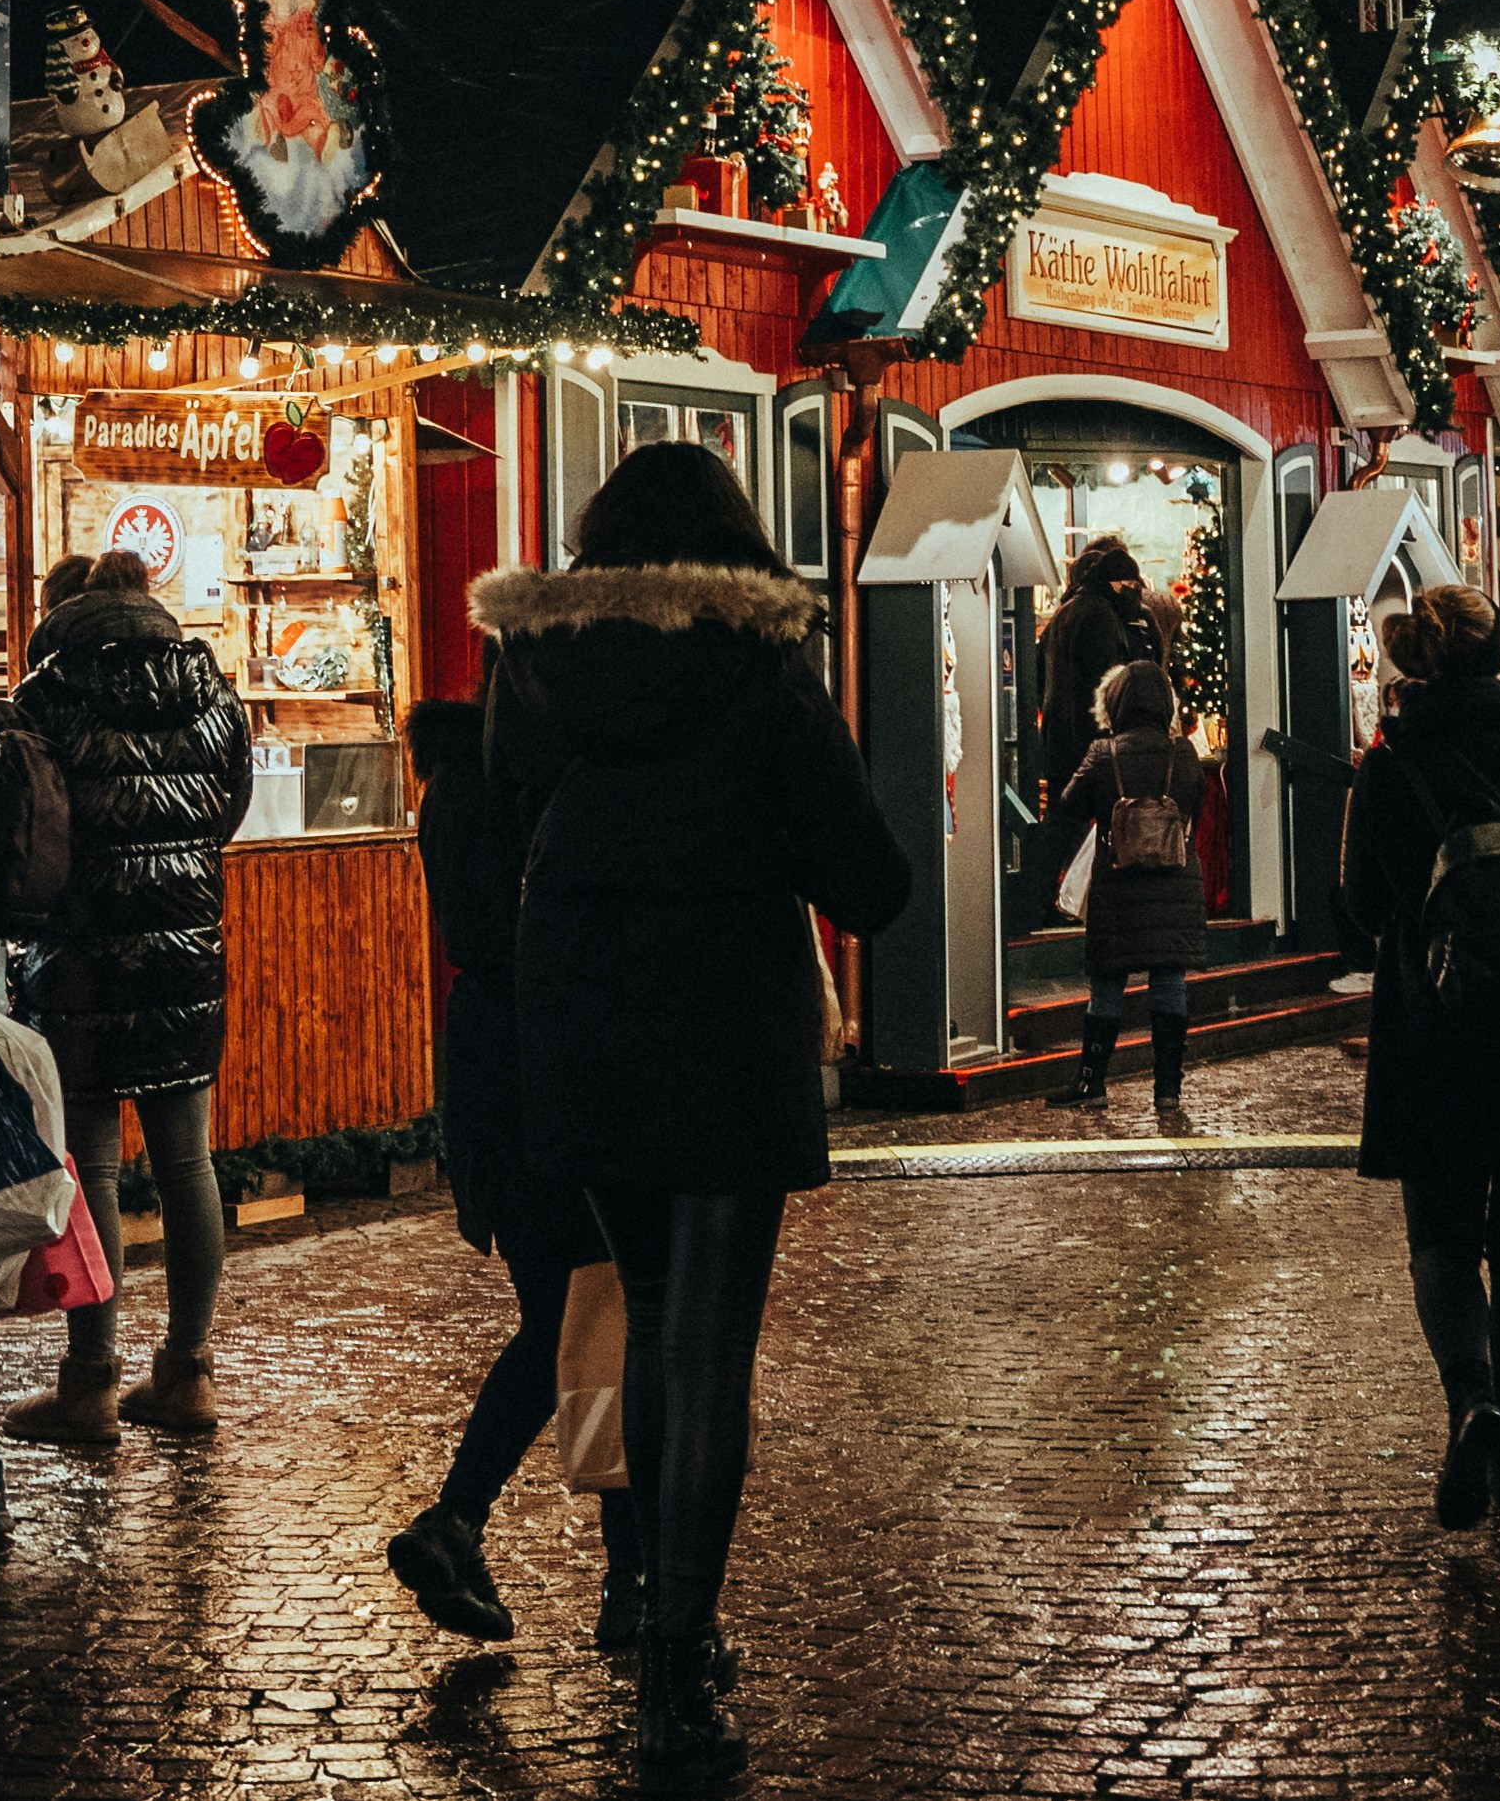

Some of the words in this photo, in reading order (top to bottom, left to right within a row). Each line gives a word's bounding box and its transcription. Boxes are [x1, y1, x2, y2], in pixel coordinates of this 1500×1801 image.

[1027, 230, 1098, 287] Käthe
[1103, 244, 1212, 308] Wohlfahrt
[84, 413, 179, 450] Paradies
[179, 399, 262, 472] Äpfel
